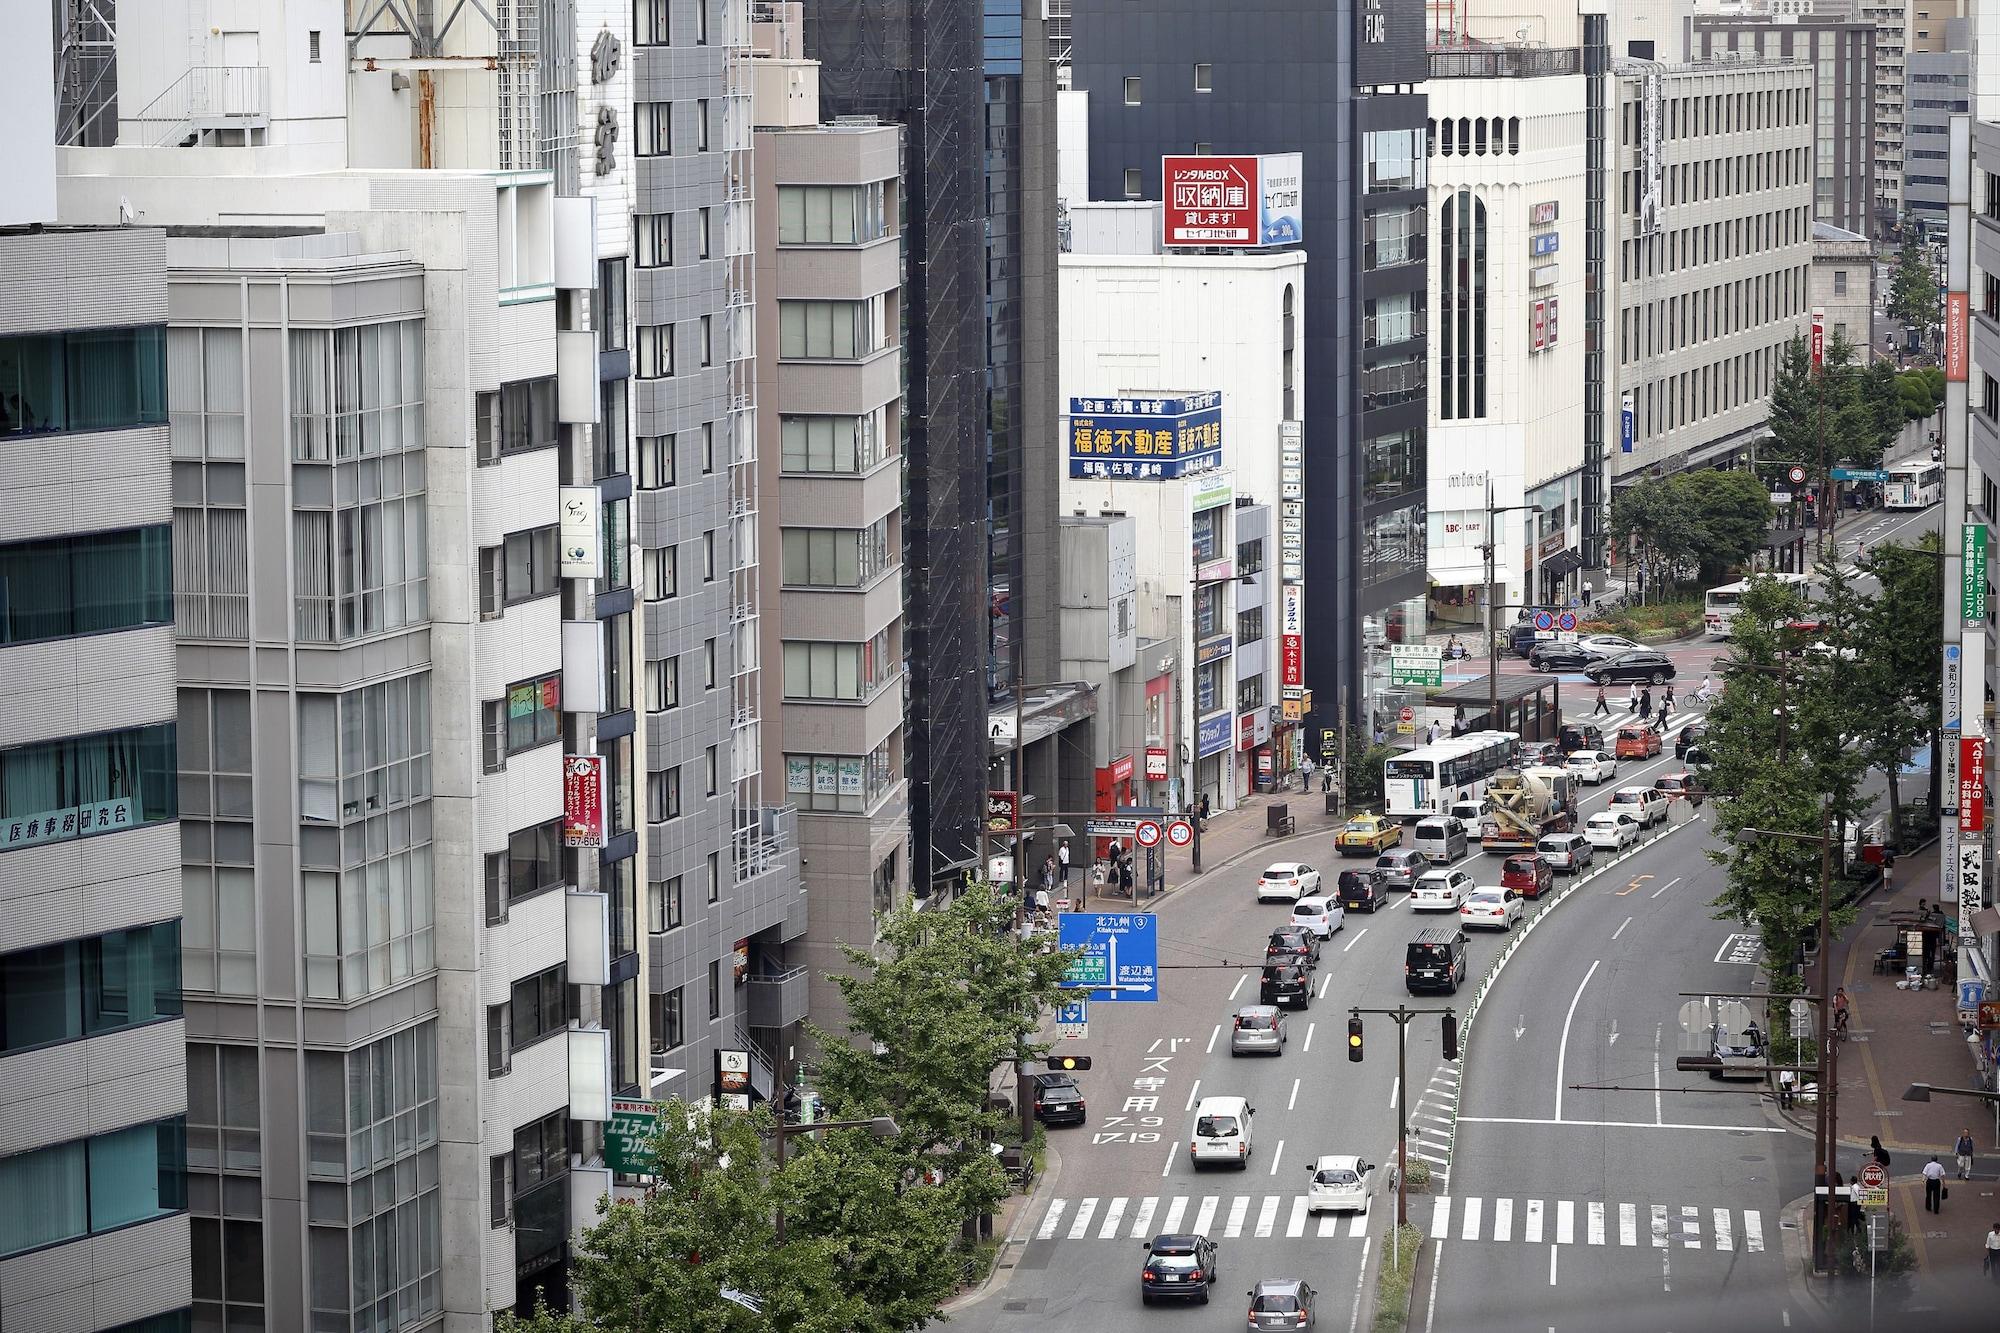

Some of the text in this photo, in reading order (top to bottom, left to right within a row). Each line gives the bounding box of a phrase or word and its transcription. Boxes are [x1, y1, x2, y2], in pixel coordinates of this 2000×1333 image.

[1366, 14, 1385, 43] FLAG
[1174, 170, 1229, 180] レンタルBOX
[1177, 186, 1244, 207] 収納庫
[1185, 212, 1236, 225] 貸します!
[1186, 229, 1237, 238] セイワ地研
[1083, 401, 1163, 413] 企画・売買・管理
[1075, 428, 1173, 455] 福徳不動産
[1178, 421, 1220, 454] 福徳不動産
[1083, 461, 1162, 477] 福岡・佐賀・長崎
[1448, 471, 1484, 487] mina
[1976, 568, 1984, 618] 752-0090
[1967, 619, 1980, 628] 9F
[1948, 664, 1957, 718] 愛和クリニック
[1323, 731, 1334, 740] P
[1972, 741, 1983, 799] ベターホームの
[1961, 780, 1972, 828] お料理教室
[0, 804, 126, 843] 医療事務研究会
[1173, 828, 1187, 839] 50
[1965, 832, 1978, 840] 3F
[565, 836, 601, 847] 157-604
[1961, 850, 1981, 908] 武田塾
[1096, 916, 1144, 927] 北九州 3
[1963, 937, 1977, 946] 2F
[1074, 958, 1105, 967] 市高速
[1102, 1116, 1164, 1129] 7-9
[1092, 1132, 1161, 1145] 17-19
